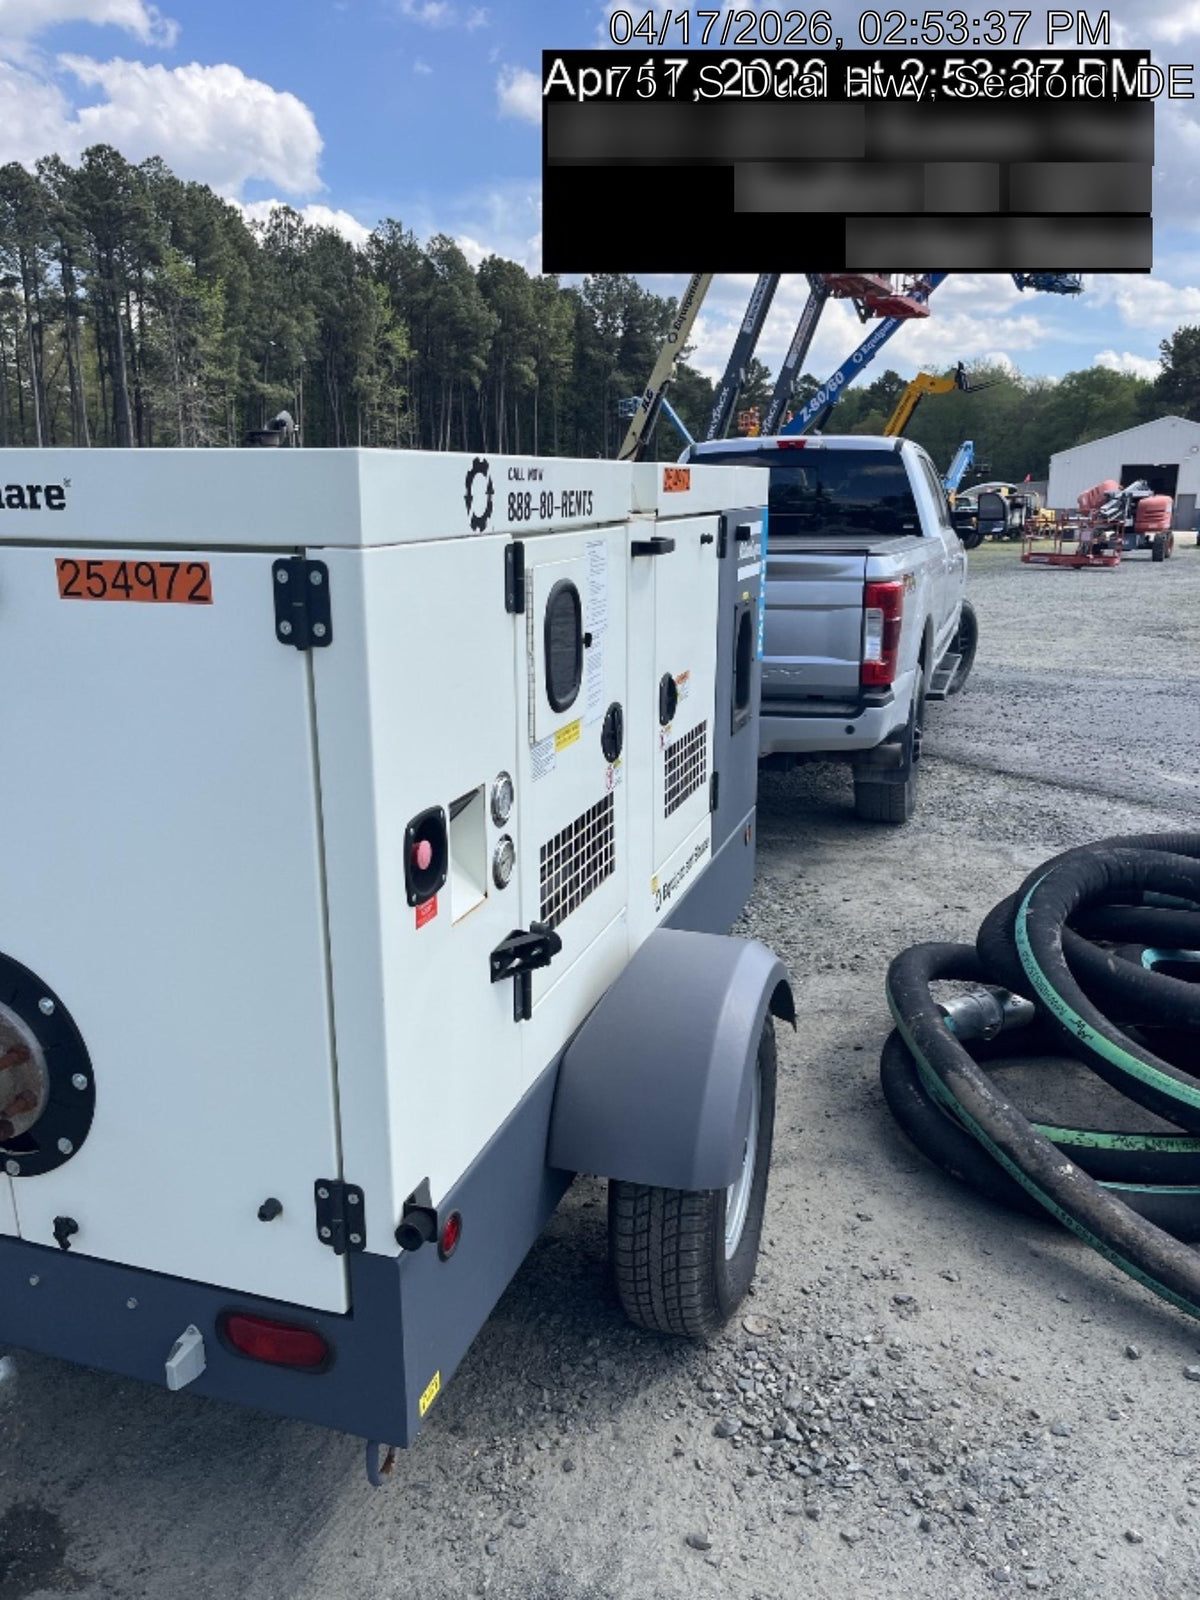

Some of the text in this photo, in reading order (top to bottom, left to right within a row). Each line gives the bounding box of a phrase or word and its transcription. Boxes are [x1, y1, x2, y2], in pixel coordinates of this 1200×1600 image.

[508, 467, 525, 481] CALL
[508, 490, 593, 521] 888-80-RENTS
[59, 559, 210, 601] 254972
